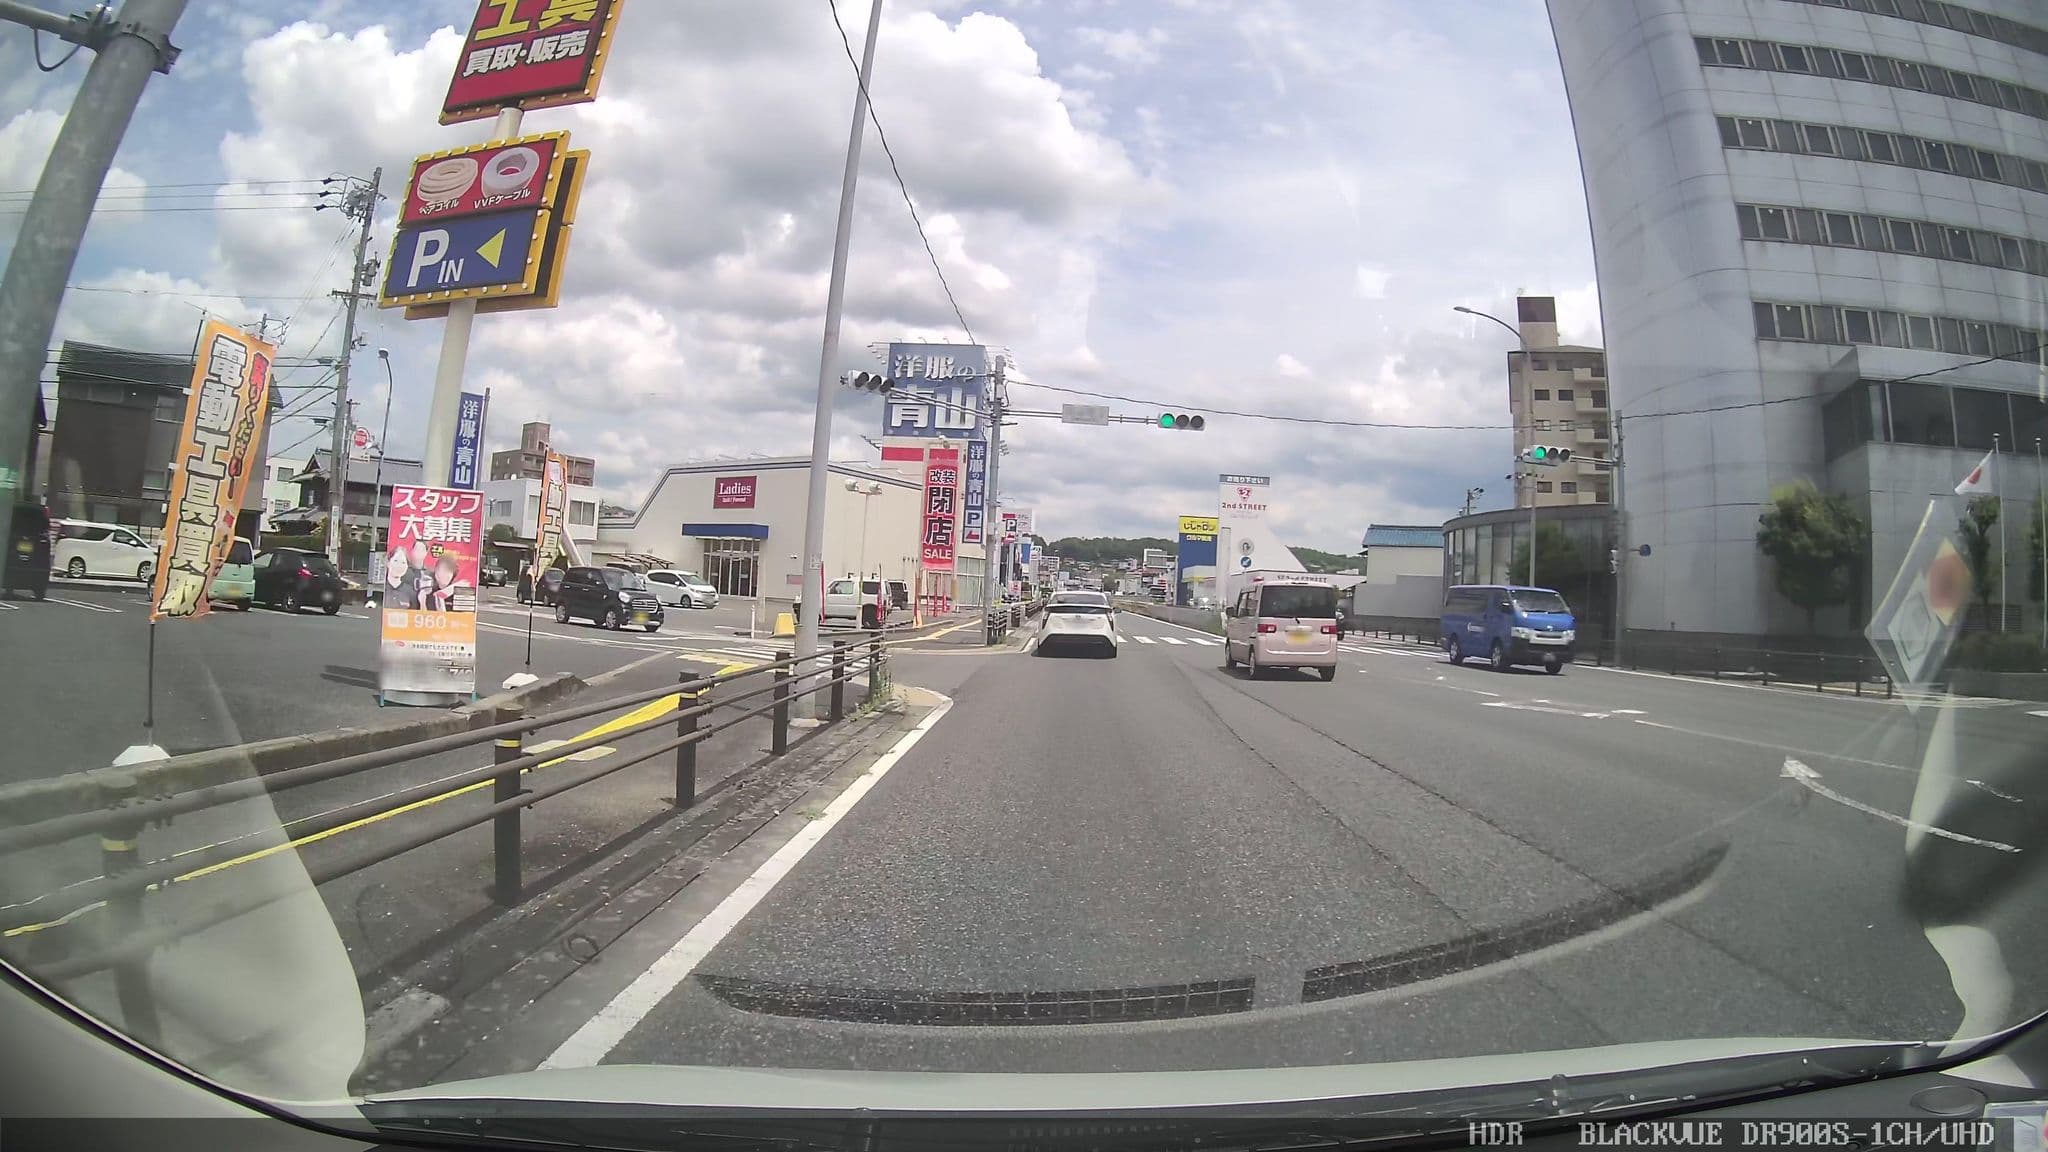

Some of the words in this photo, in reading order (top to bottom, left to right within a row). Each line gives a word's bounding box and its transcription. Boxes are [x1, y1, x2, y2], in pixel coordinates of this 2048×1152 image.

[463, 29, 590, 77] 買取・販売
[474, 188, 531, 209] VVFケーブル
[894, 354, 977, 382] 洋服の
[888, 383, 977, 429] 青山
[454, 400, 480, 485] 洋服の青山
[159, 334, 248, 616] 電動工具買取
[719, 482, 752, 494] Ladies
[929, 470, 956, 483] 改装
[967, 445, 985, 507] 洋服の青山
[395, 488, 481, 514] スタッフ
[1239, 503, 1267, 511] STREET
[398, 514, 473, 543] 大募集
[925, 486, 954, 546] 閉店
[967, 512, 980, 524] P
[1007, 519, 1016, 531] P
[924, 548, 952, 560] SALE
[414, 614, 447, 629] 960
